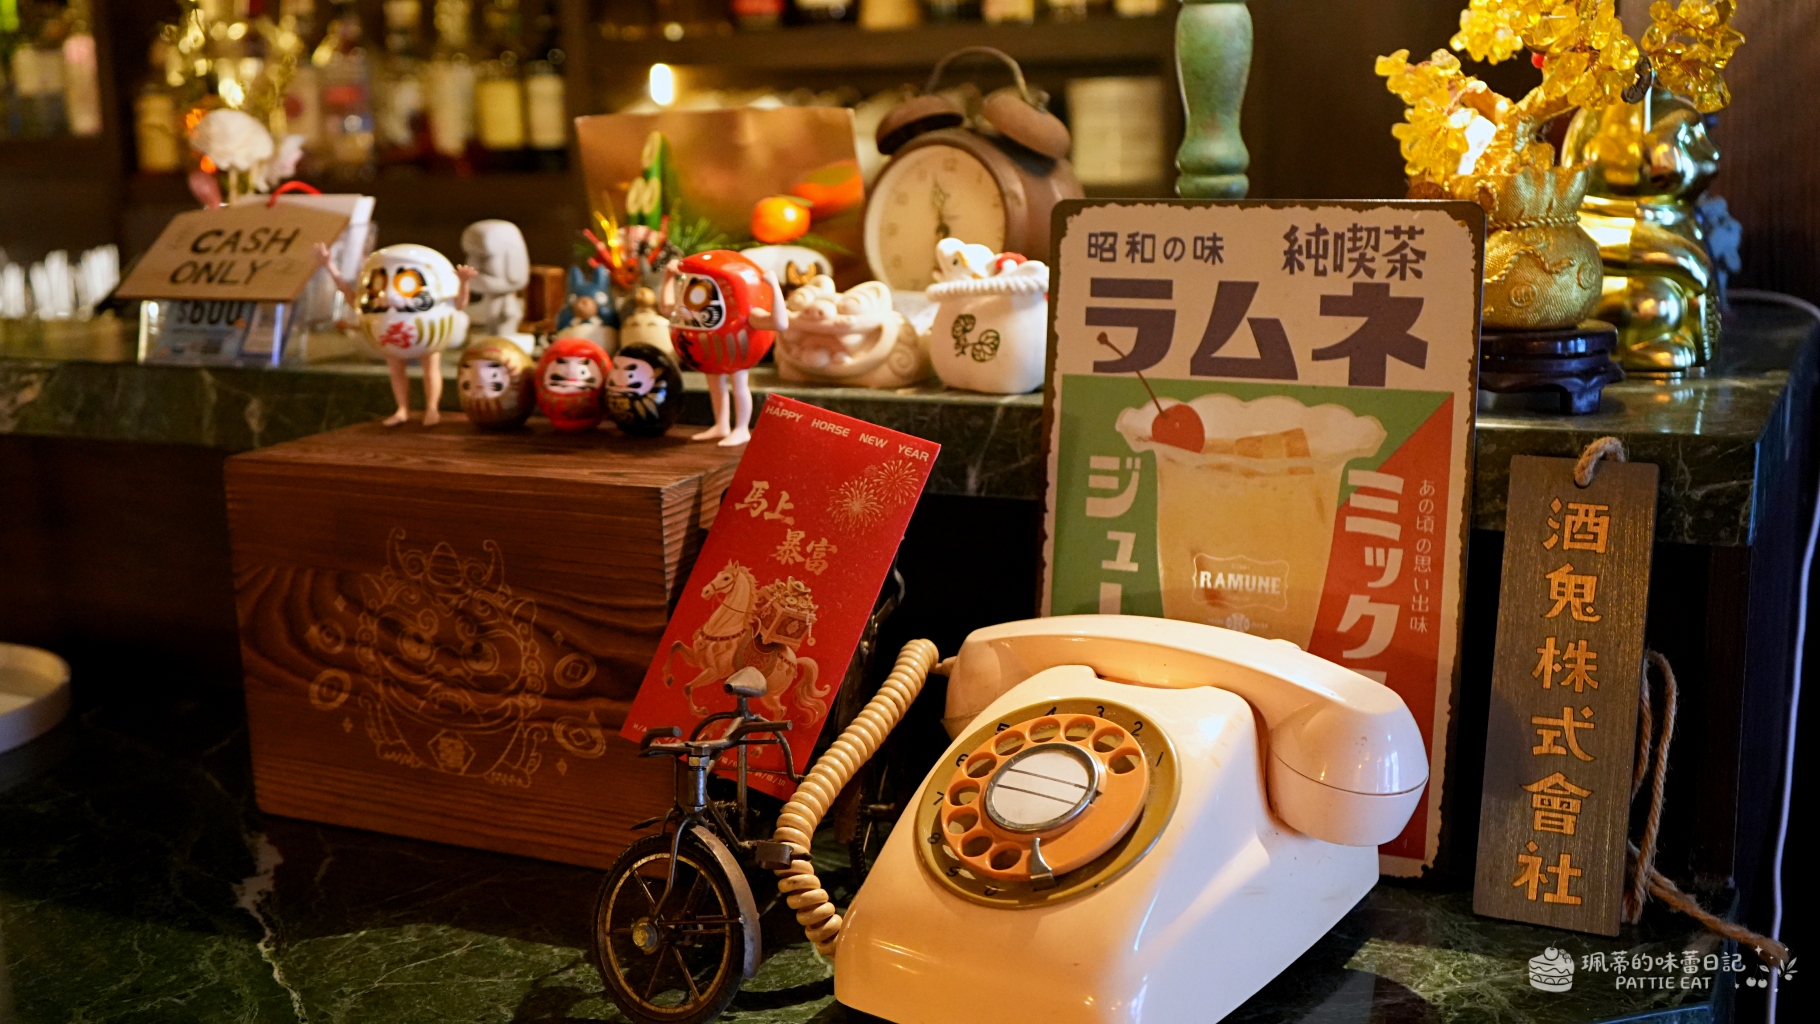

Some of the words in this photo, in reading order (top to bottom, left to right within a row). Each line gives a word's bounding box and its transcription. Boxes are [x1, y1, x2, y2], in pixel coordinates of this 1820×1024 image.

[191, 227, 300, 255] CASH
[1087, 231, 1225, 266] 昭和の味
[1282, 223, 1427, 281] 純喫茶
[170, 259, 271, 285] ONLY
[1085, 277, 1429, 388] ラムネ
[765, 405, 803, 423] HAPPY
[811, 418, 851, 437] HORSE
[858, 432, 889, 448] NEW
[898, 443, 930, 462] YEAR
[735, 480, 795, 526] 馬上
[770, 528, 838, 575] 暴富
[1409, 479, 1436, 634] あの頃の思い出味
[1199, 570, 1281, 595] RAMUNE
[1336, 469, 1405, 685] ミック
[1512, 496, 1611, 906] 酒鬼株式會社
[1131, 720, 1144, 737] 2
[1155, 751, 1164, 768] 1
